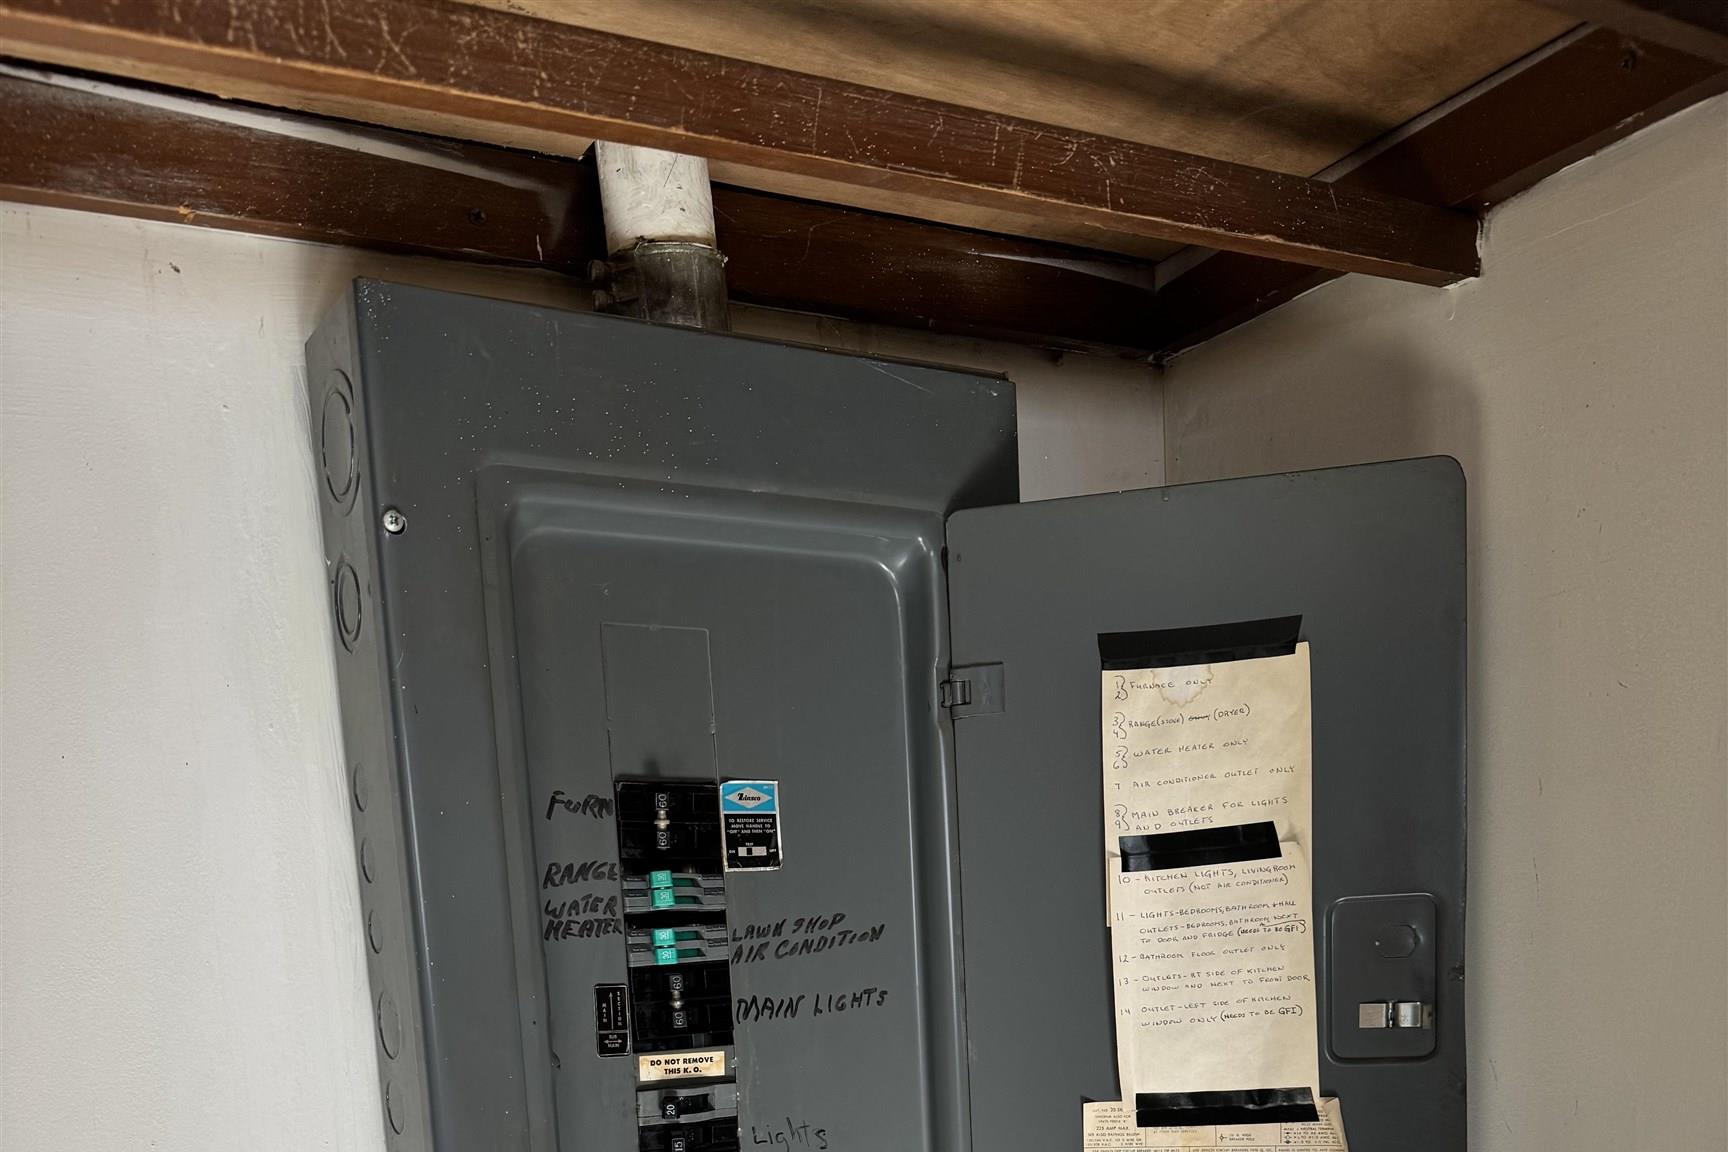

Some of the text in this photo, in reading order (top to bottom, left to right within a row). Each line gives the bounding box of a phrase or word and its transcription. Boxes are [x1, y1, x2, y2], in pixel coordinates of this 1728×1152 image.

[1129, 681, 1175, 690] FURNACE
[1133, 738, 1249, 758] WATER HEATER ONLY
[1132, 780, 1151, 789] AIR
[1157, 773, 1217, 786] CONDITIONER
[1224, 768, 1259, 779] OUTLET
[1269, 765, 1296, 775] ONLY
[657, 793, 668, 808] 60
[1131, 796, 1289, 820] MAIN BREAKER FOR LIGHTS
[1135, 816, 1214, 832] AND OUTLETS
[658, 831, 669, 846] 60
[543, 860, 620, 889] RANGE
[1118, 874, 1131, 885] 10
[1144, 872, 1188, 883] KITCHEN
[544, 893, 618, 921] WATER
[793, 913, 846, 935] SHOP
[1116, 912, 1125, 921] 11
[544, 917, 623, 941] HEATER
[1202, 930, 1234, 939] FRIDGE
[731, 924, 886, 965] AIR CONDITION
[1118, 954, 1129, 963] 12
[1222, 946, 1255, 955] OUTLET
[1261, 943, 1286, 951] ONLY
[1118, 977, 1129, 987] 13
[1205, 970, 1226, 978] SIDE
[1247, 965, 1285, 975] KITCHEN
[1287, 974, 1311, 982] DOOR
[813, 987, 890, 1016] LIGHTS
[1120, 1008, 1131, 1016] 14
[1189, 1015, 1218, 1024] ONLY
[664, 1058, 681, 1066] NOT
[682, 1056, 714, 1065] REMOVE
[666, 1104, 676, 1116] 20
[674, 1141, 684, 1152] 15
